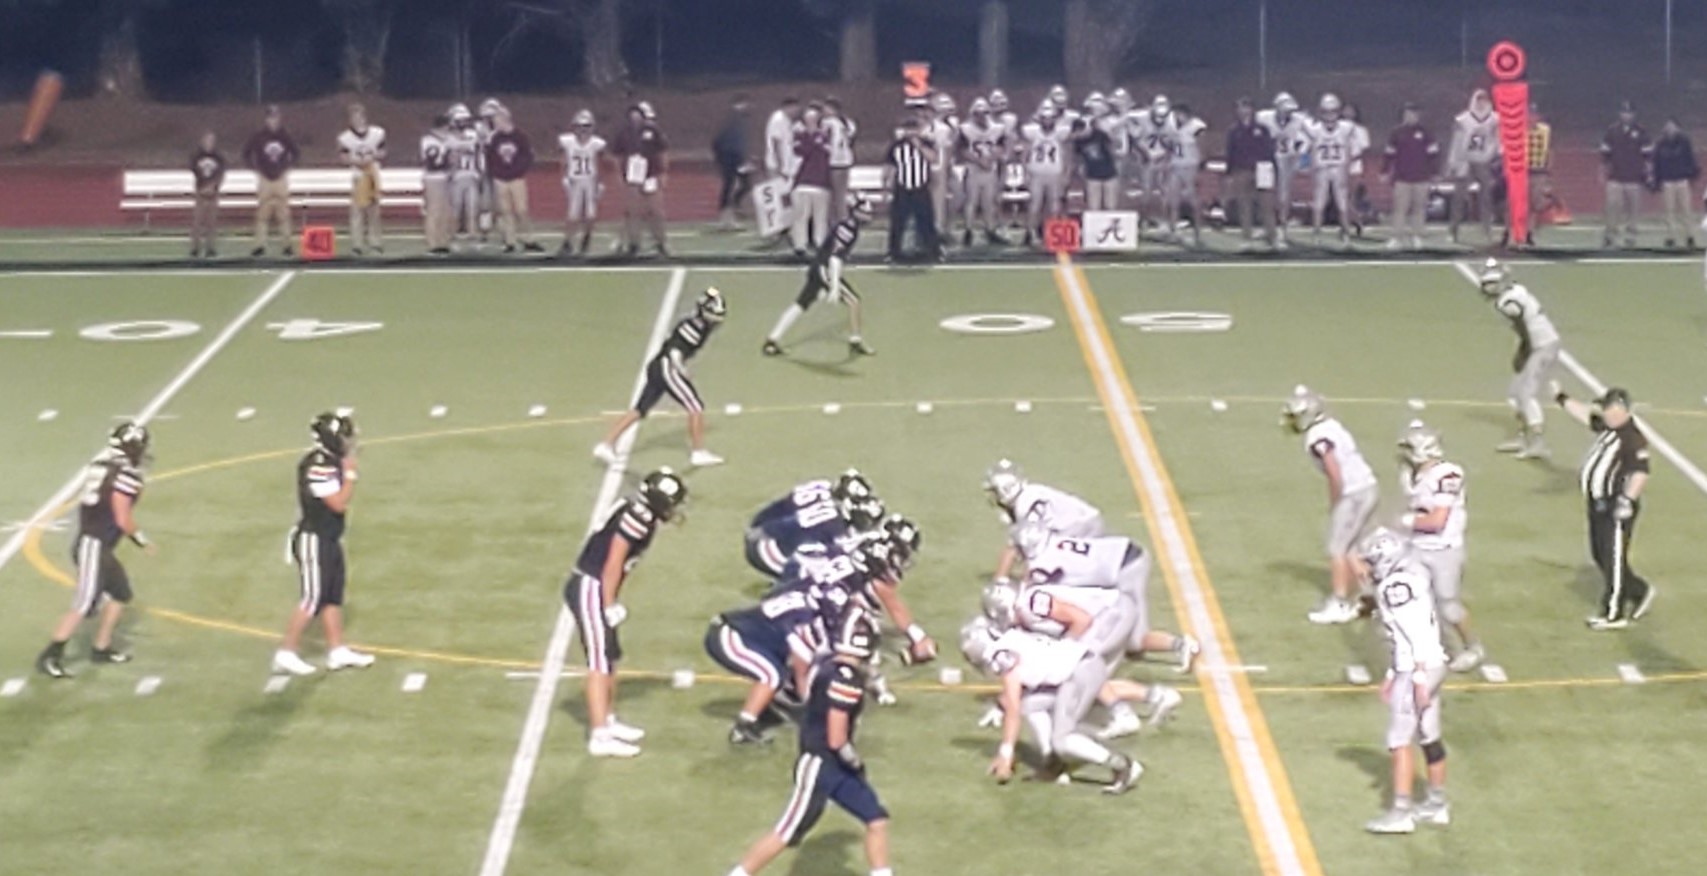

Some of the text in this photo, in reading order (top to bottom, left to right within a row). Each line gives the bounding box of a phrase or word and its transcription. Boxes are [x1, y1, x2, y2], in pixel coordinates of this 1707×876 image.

[572, 155, 592, 175] 31
[1050, 223, 1075, 246] 50
[1098, 218, 1125, 243] A
